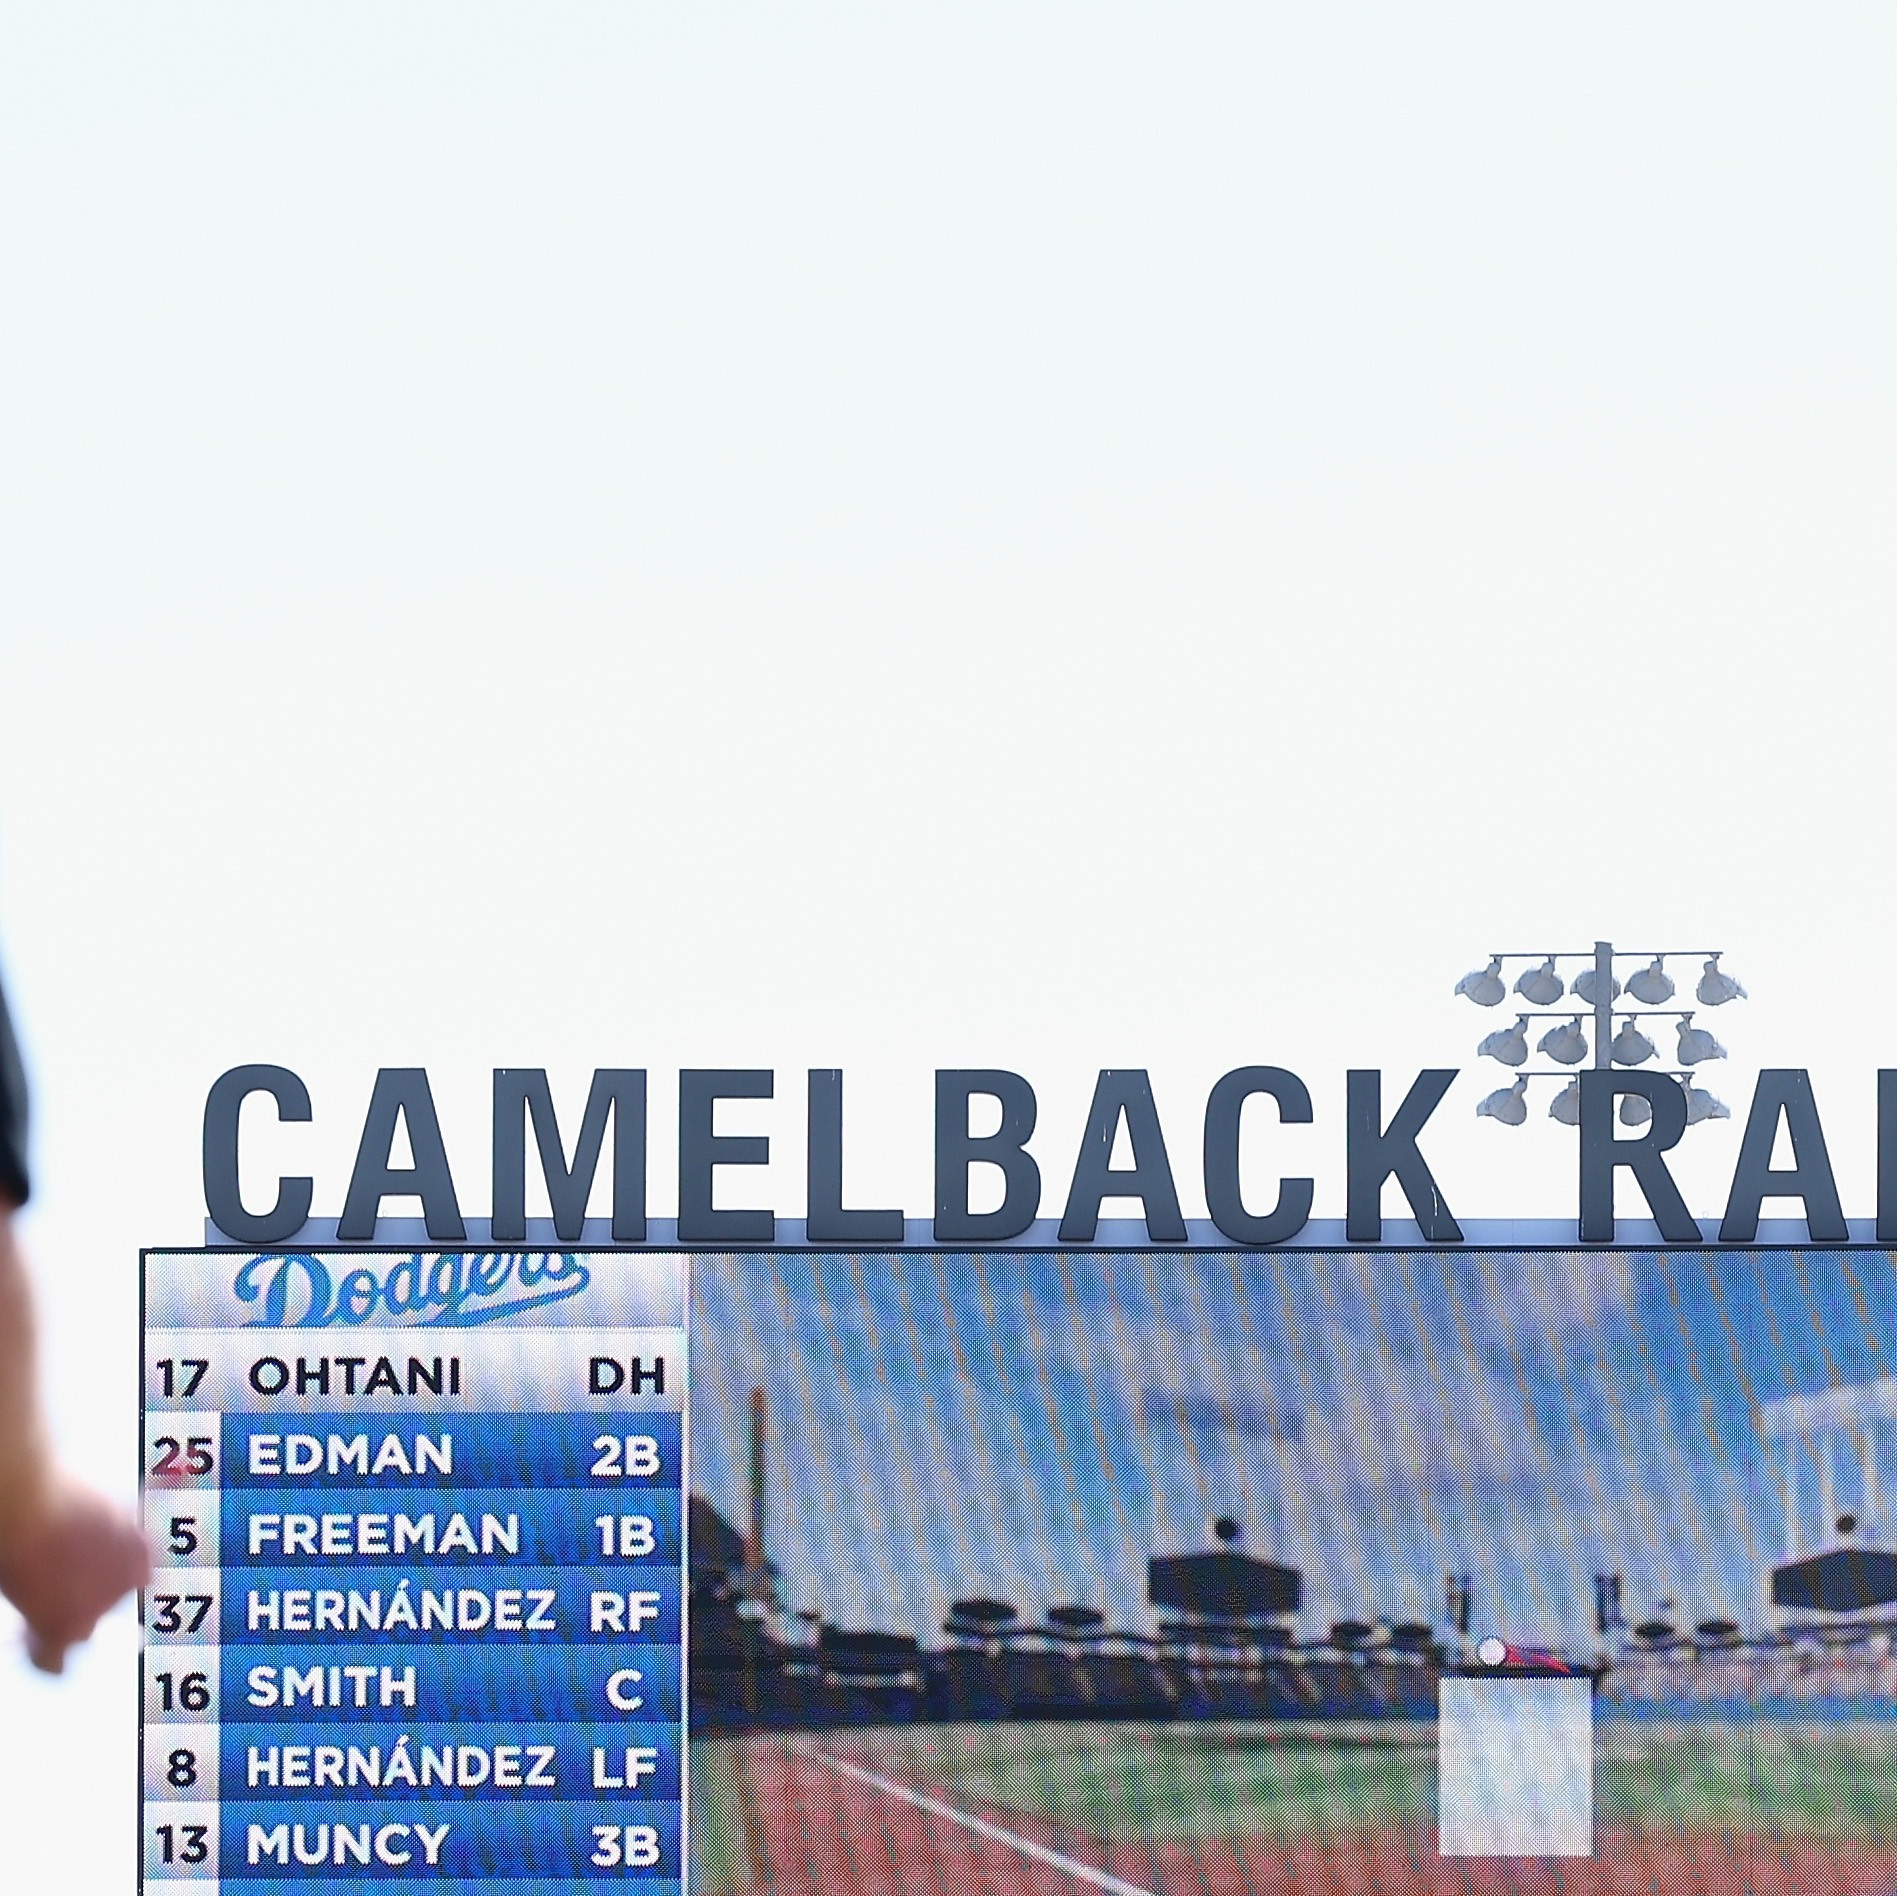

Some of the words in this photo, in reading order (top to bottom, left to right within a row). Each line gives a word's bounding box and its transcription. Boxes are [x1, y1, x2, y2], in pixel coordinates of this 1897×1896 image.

[203, 1063, 1464, 1244] CAMELBACK
[156, 1356, 209, 1397] 17
[248, 1356, 461, 1397] OHTANI
[589, 1356, 665, 1397] DH
[151, 1436, 214, 1476] 25
[248, 1434, 453, 1475] EDMAN
[590, 1434, 661, 1476] 2B
[168, 1516, 198, 1555] 5
[248, 1513, 519, 1556] FREEMAN
[595, 1515, 656, 1557] 1B
[152, 1596, 213, 1634] 37
[247, 1579, 556, 1632] HERNÁNDEZ
[590, 1591, 662, 1633] RF
[156, 1672, 207, 1711] 16
[247, 1666, 417, 1708] SMITH
[605, 1668, 644, 1711] C
[167, 1749, 198, 1788] 8
[247, 1733, 556, 1788] HERNÁNDEZ
[592, 1746, 658, 1788] LF
[156, 1824, 209, 1864] 13
[247, 1823, 452, 1865] MUNCY
[590, 1825, 660, 1868] 3B
